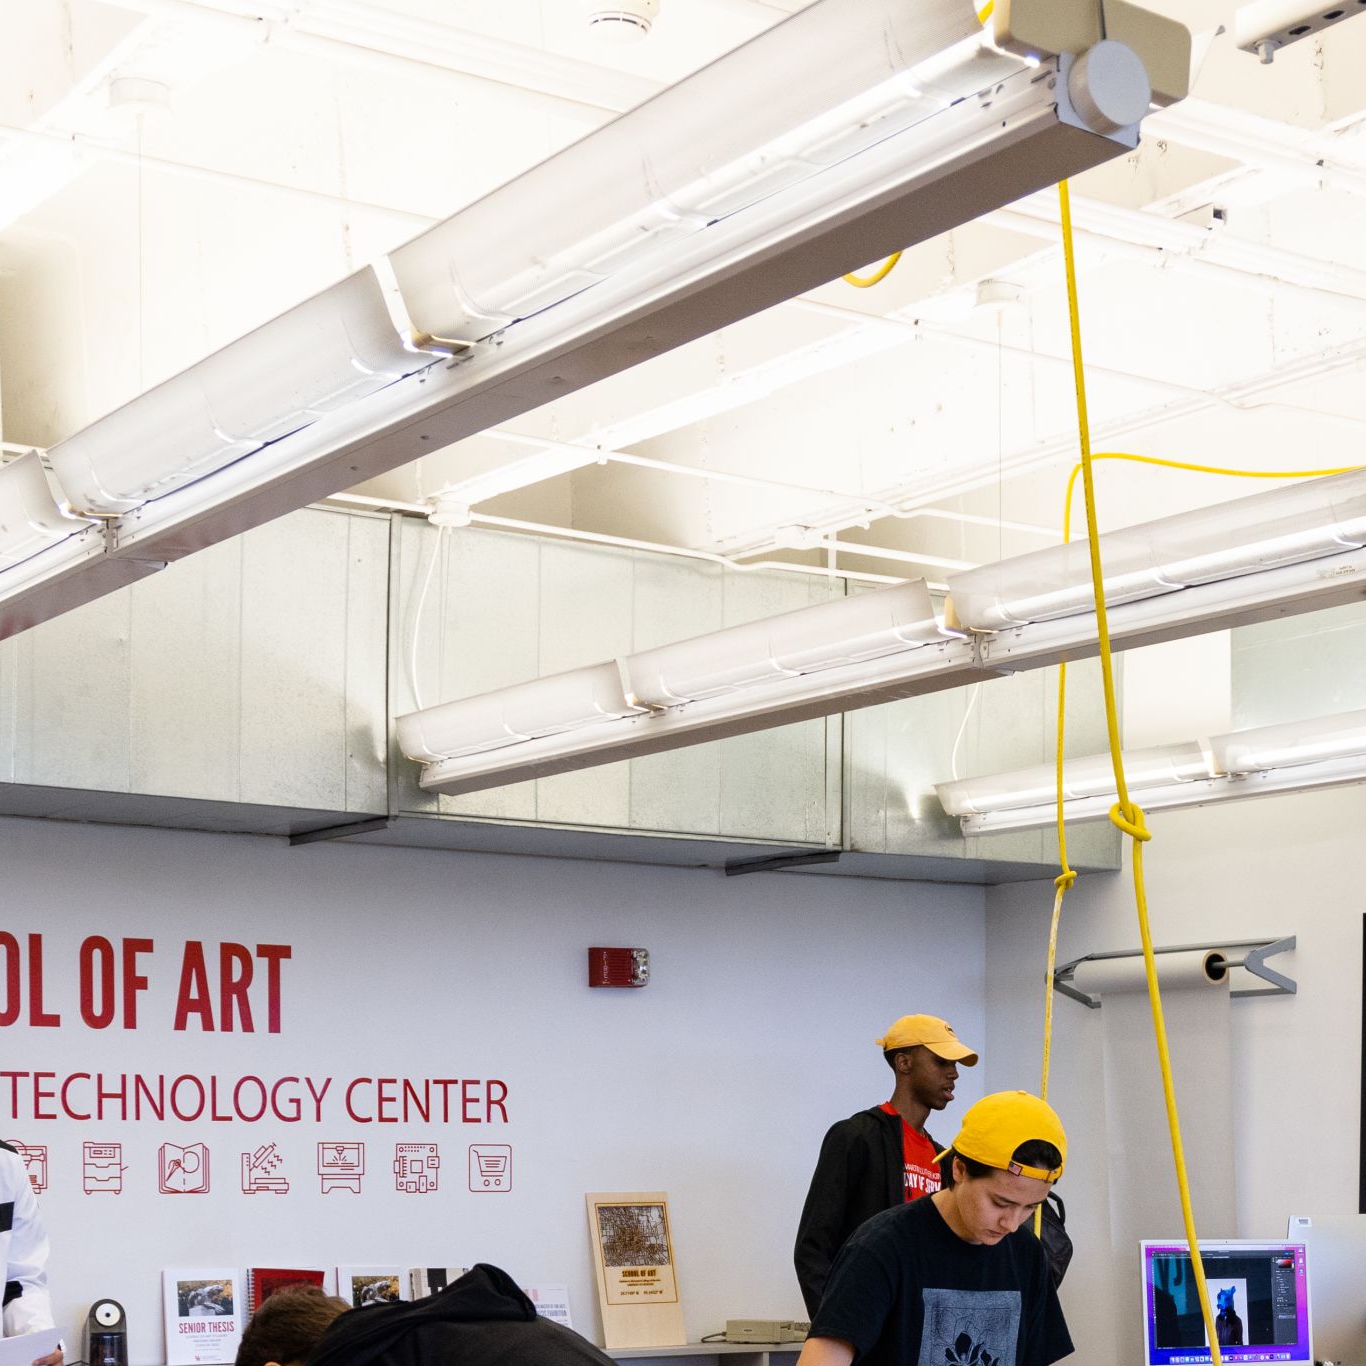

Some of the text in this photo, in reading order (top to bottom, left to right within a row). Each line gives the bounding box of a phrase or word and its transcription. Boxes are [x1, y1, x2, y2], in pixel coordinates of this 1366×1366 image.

[79, 935, 154, 1030] OF
[173, 940, 292, 1033] ART
[0, 1072, 333, 1123] TECHNOLOGY
[345, 1077, 509, 1124] CENTER
[178, 1321, 235, 1334] SENIOR THESIS
